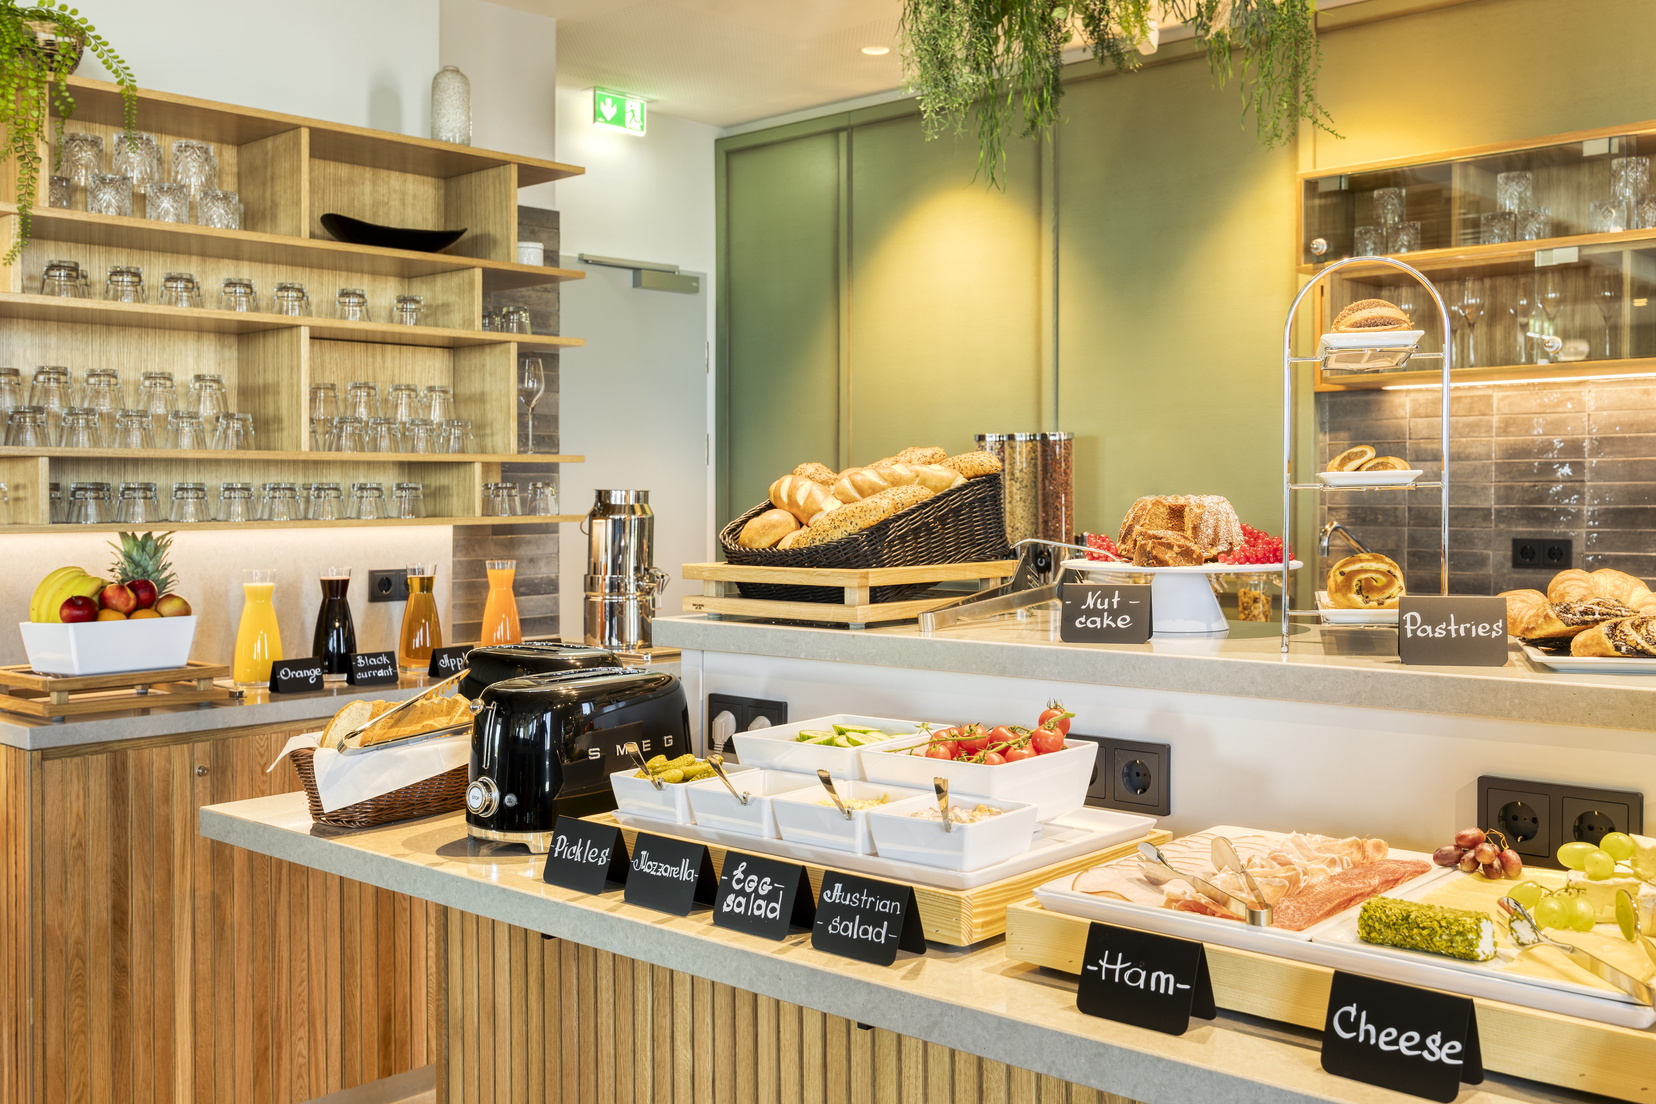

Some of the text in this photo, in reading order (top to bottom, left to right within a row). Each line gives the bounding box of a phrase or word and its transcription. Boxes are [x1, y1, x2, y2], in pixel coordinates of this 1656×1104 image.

[1075, 611, 1133, 629] cake
[1402, 611, 1503, 639] Pastries
[588, 735, 673, 760] SMEG
[722, 889, 783, 921] salad
[823, 883, 901, 915] Austrian
[1333, 1002, 1463, 1065] Cheese
